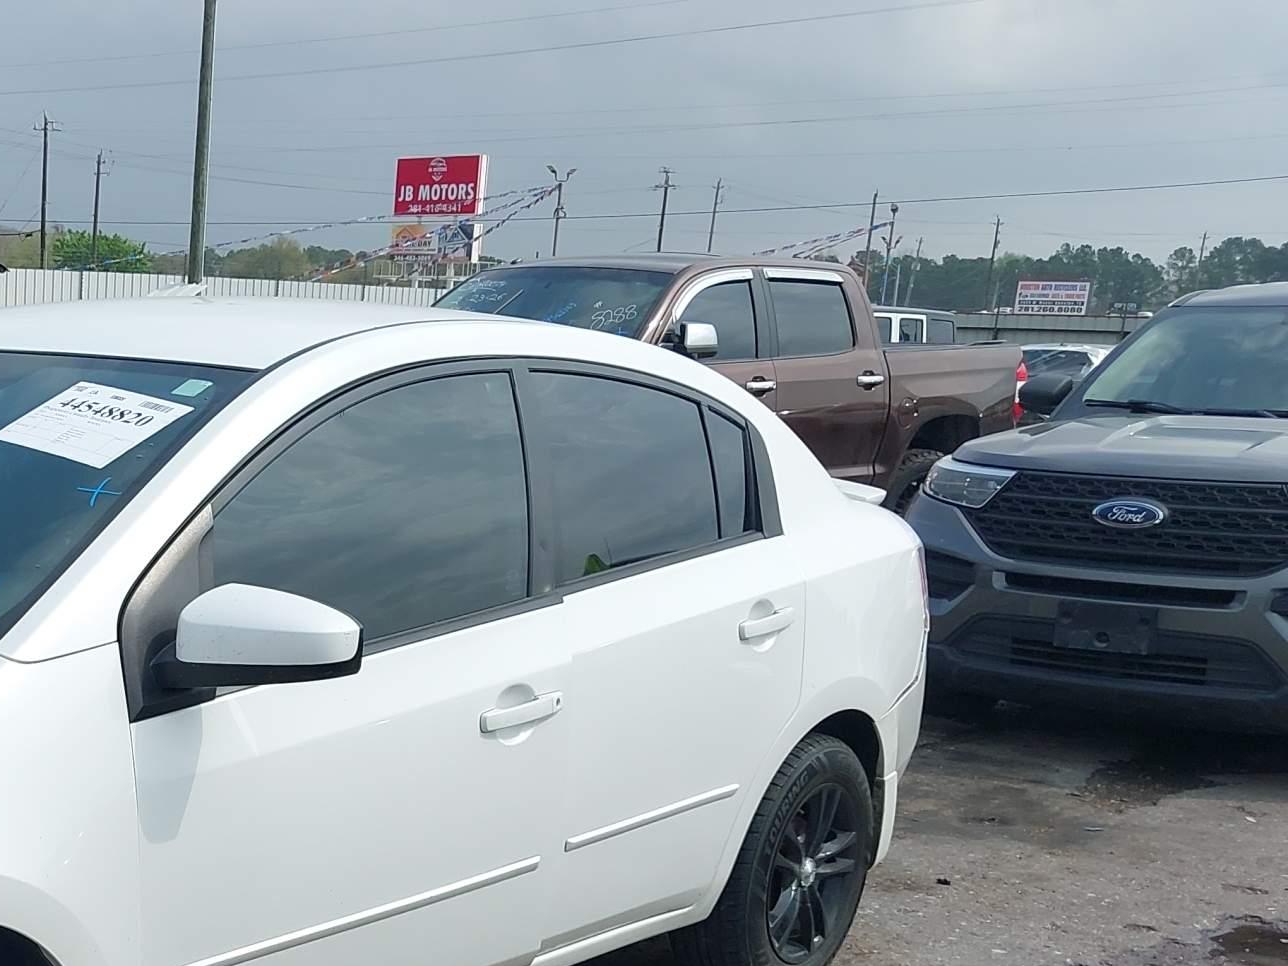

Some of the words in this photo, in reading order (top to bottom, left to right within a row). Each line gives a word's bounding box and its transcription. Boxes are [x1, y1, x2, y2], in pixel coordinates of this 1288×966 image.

[398, 185, 413, 202] JB
[418, 183, 474, 201] MOTORS
[59, 397, 154, 427] 44548820
[1107, 505, 1147, 522] Ford
